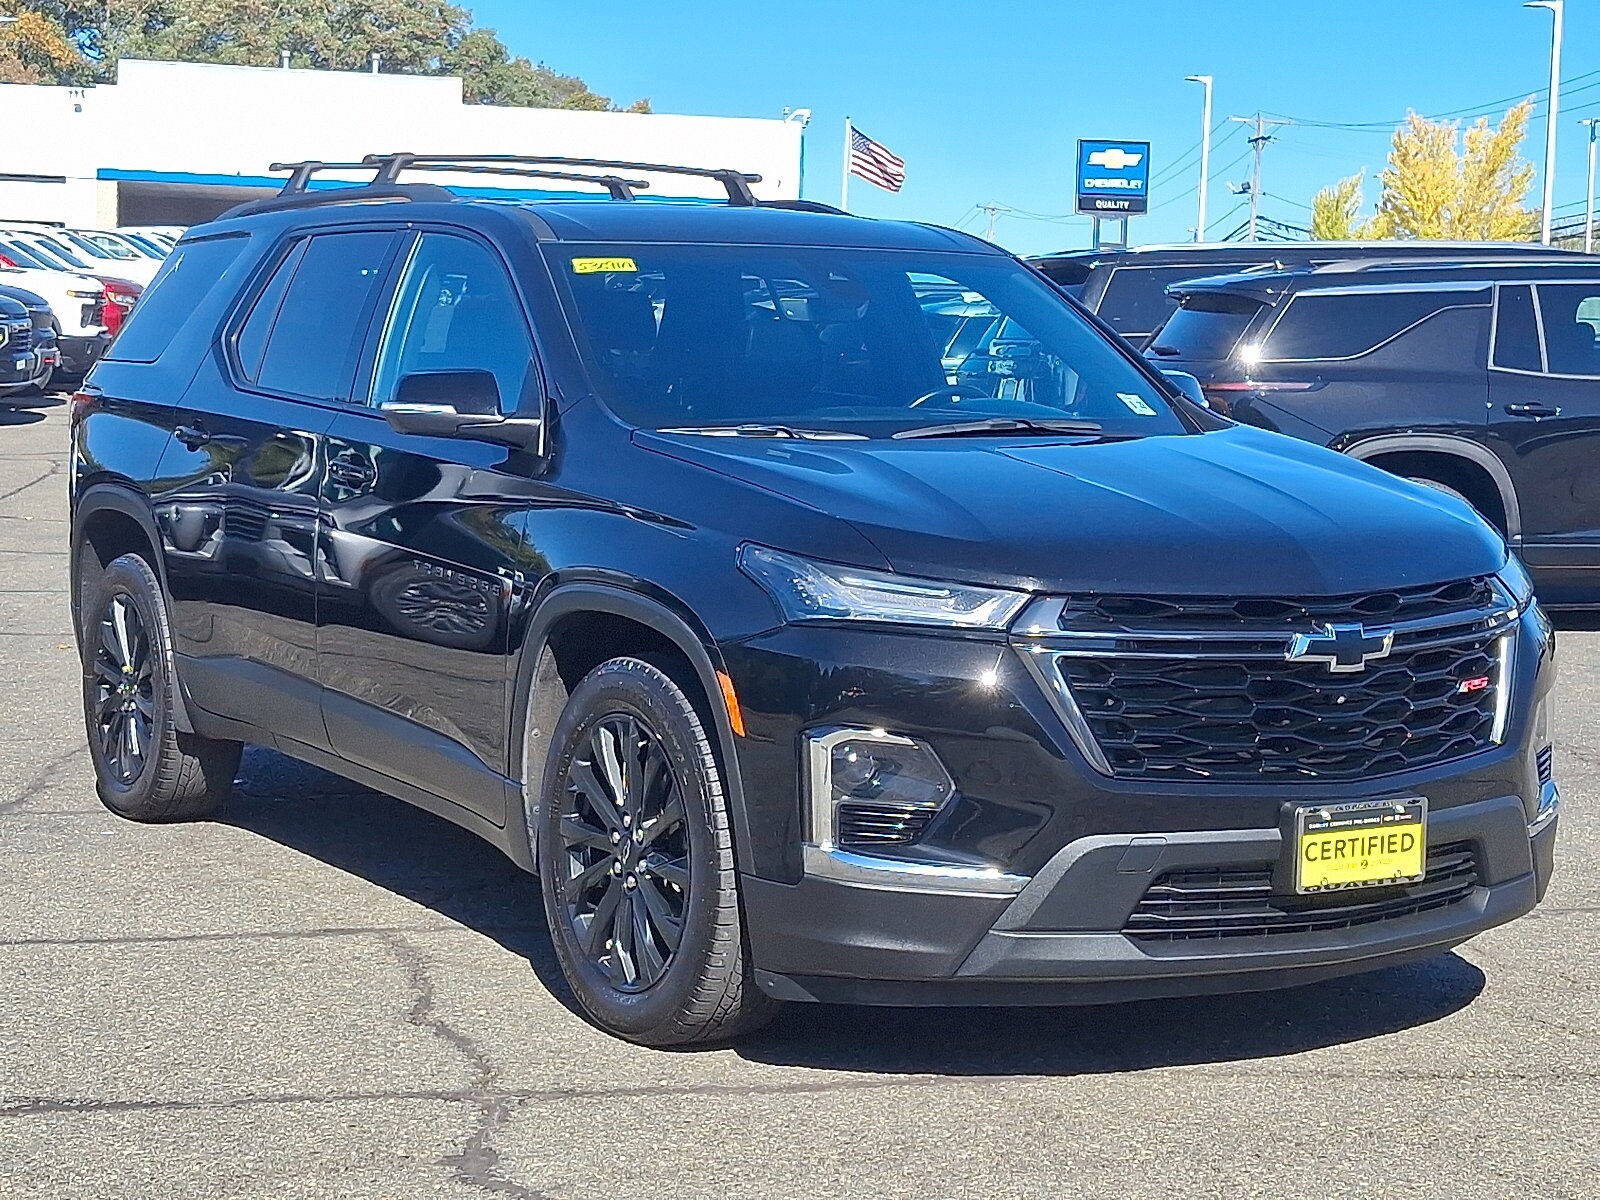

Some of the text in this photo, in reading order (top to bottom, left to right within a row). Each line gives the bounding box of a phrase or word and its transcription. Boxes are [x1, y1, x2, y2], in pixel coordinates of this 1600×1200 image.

[1096, 200, 1129, 209] QUALITY
[1459, 676, 1489, 693] RS
[1304, 832, 1415, 862] CERTIFIED
